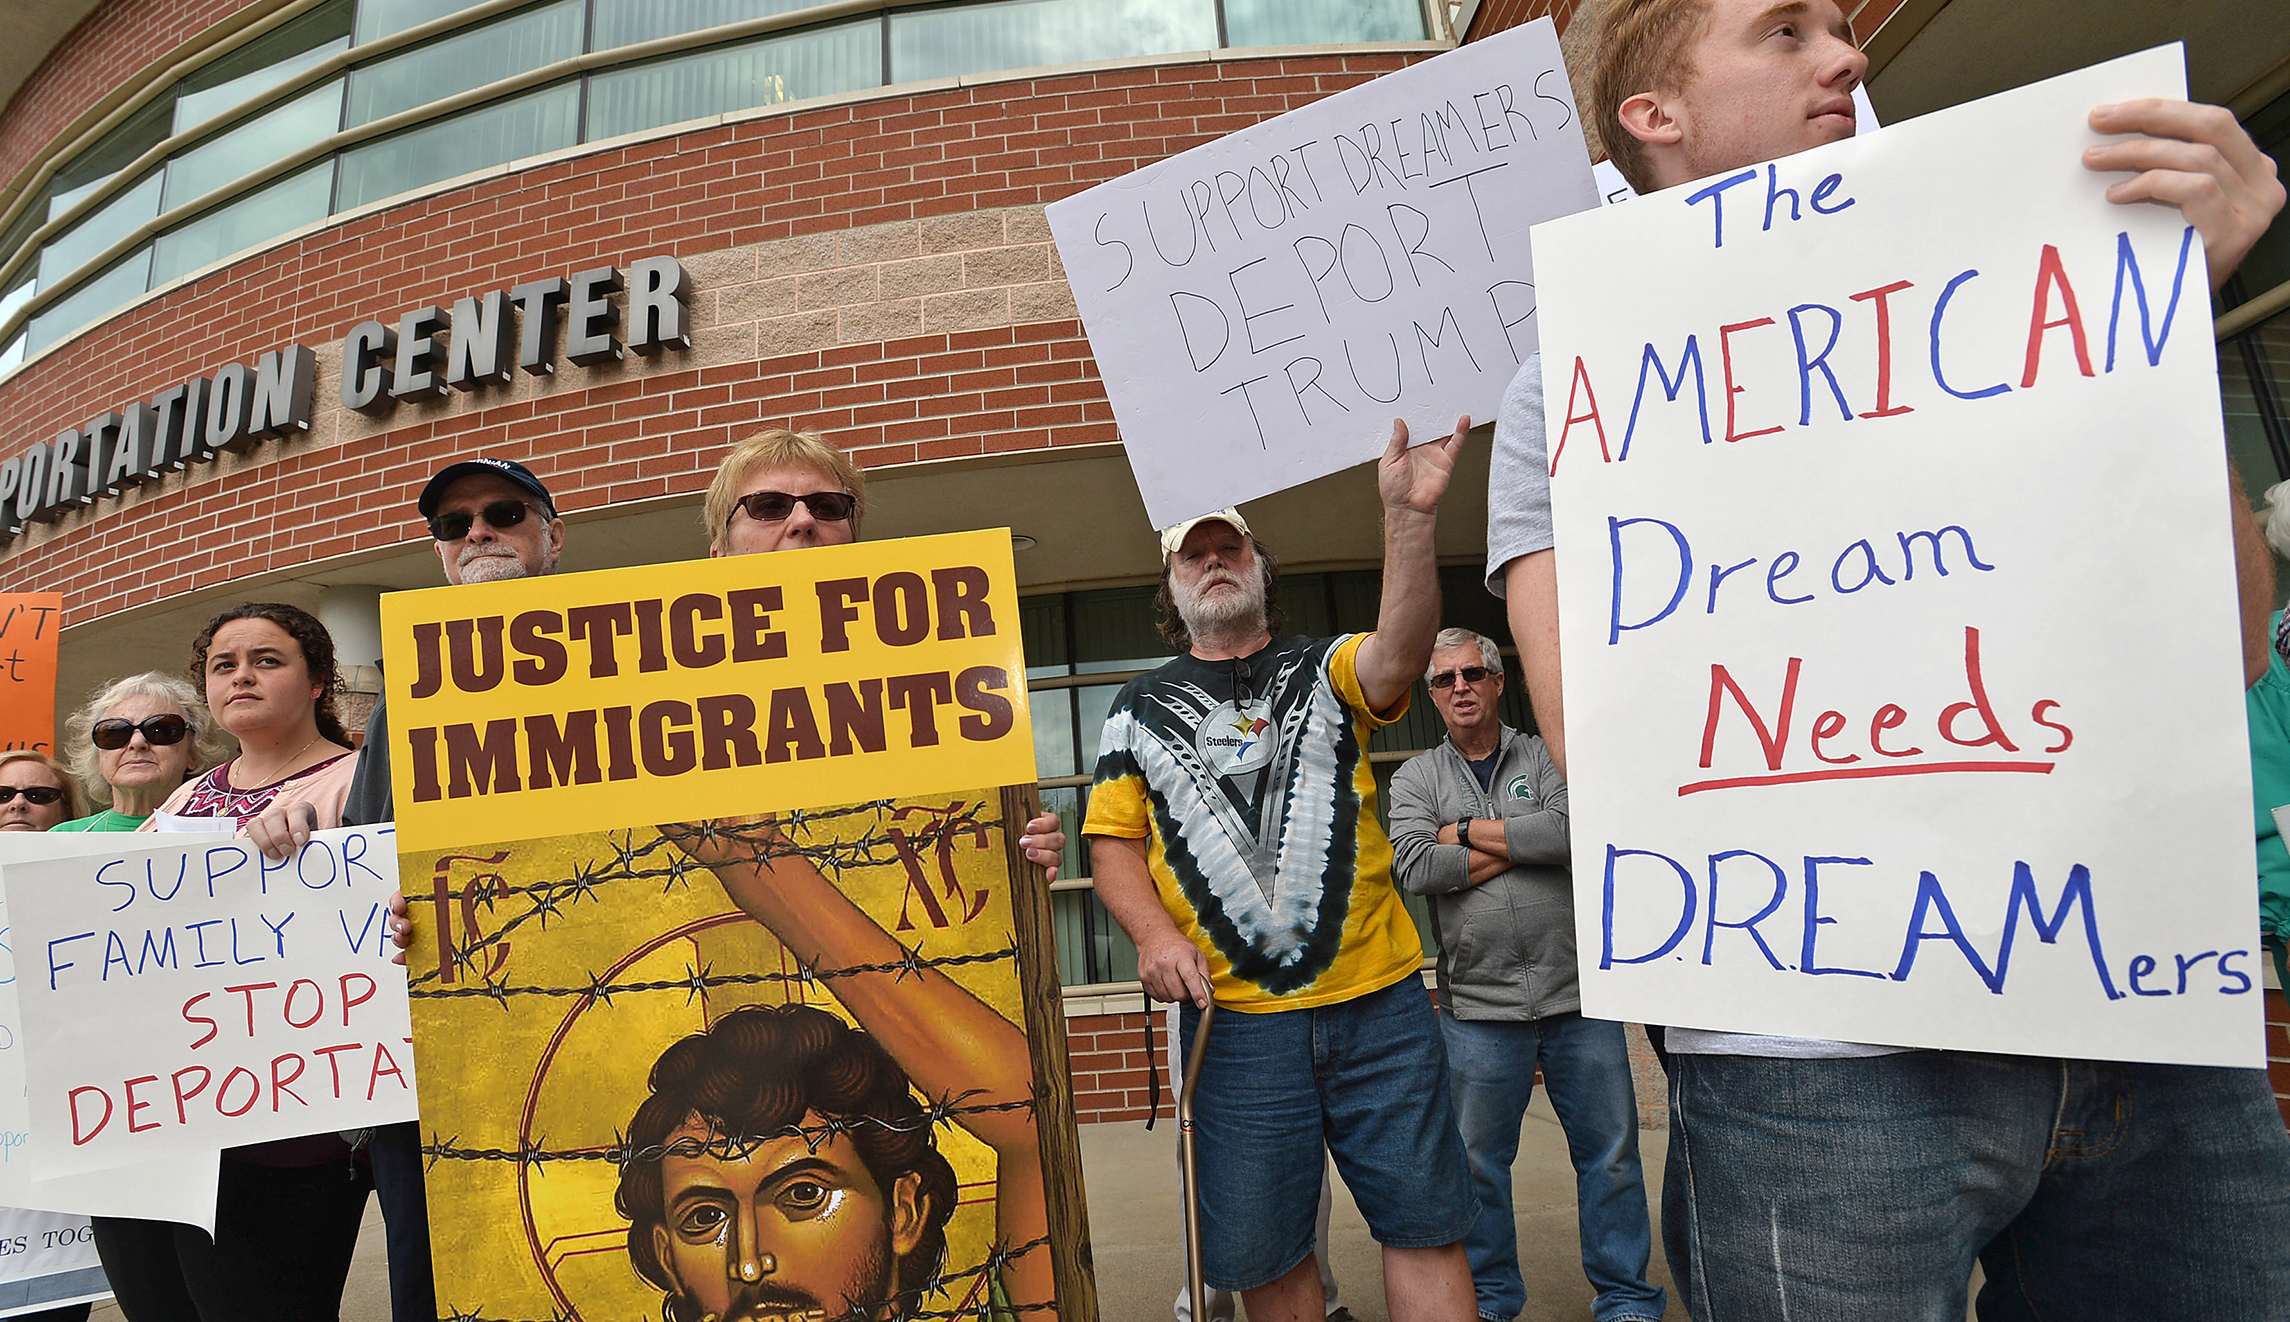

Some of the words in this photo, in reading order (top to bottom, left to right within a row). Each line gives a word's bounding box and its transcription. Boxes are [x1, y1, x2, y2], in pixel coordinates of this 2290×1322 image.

[1094, 140, 1323, 292] SUPPORT
[1333, 69, 1572, 196] DREAMERS
[1685, 163, 1856, 248] The
[340, 255, 691, 412] CENTER
[1169, 162, 1509, 373] DEPORT
[1219, 280, 1537, 451] TRUMP
[1548, 225, 2194, 478] AMERICAN
[410, 584, 788, 699] JUSTICE
[814, 565, 997, 654] FOR
[1607, 515, 1996, 645] Dream
[408, 665, 1014, 803] IMMIGRANTS
[1206, 735, 1244, 747] Steelers
[1698, 625, 2074, 771] Needs
[95, 828, 395, 913] SUPPOR
[47, 911, 296, 990] FAMILY
[181, 971, 378, 1051] STOP
[68, 1036, 413, 1147] DEPORTA
